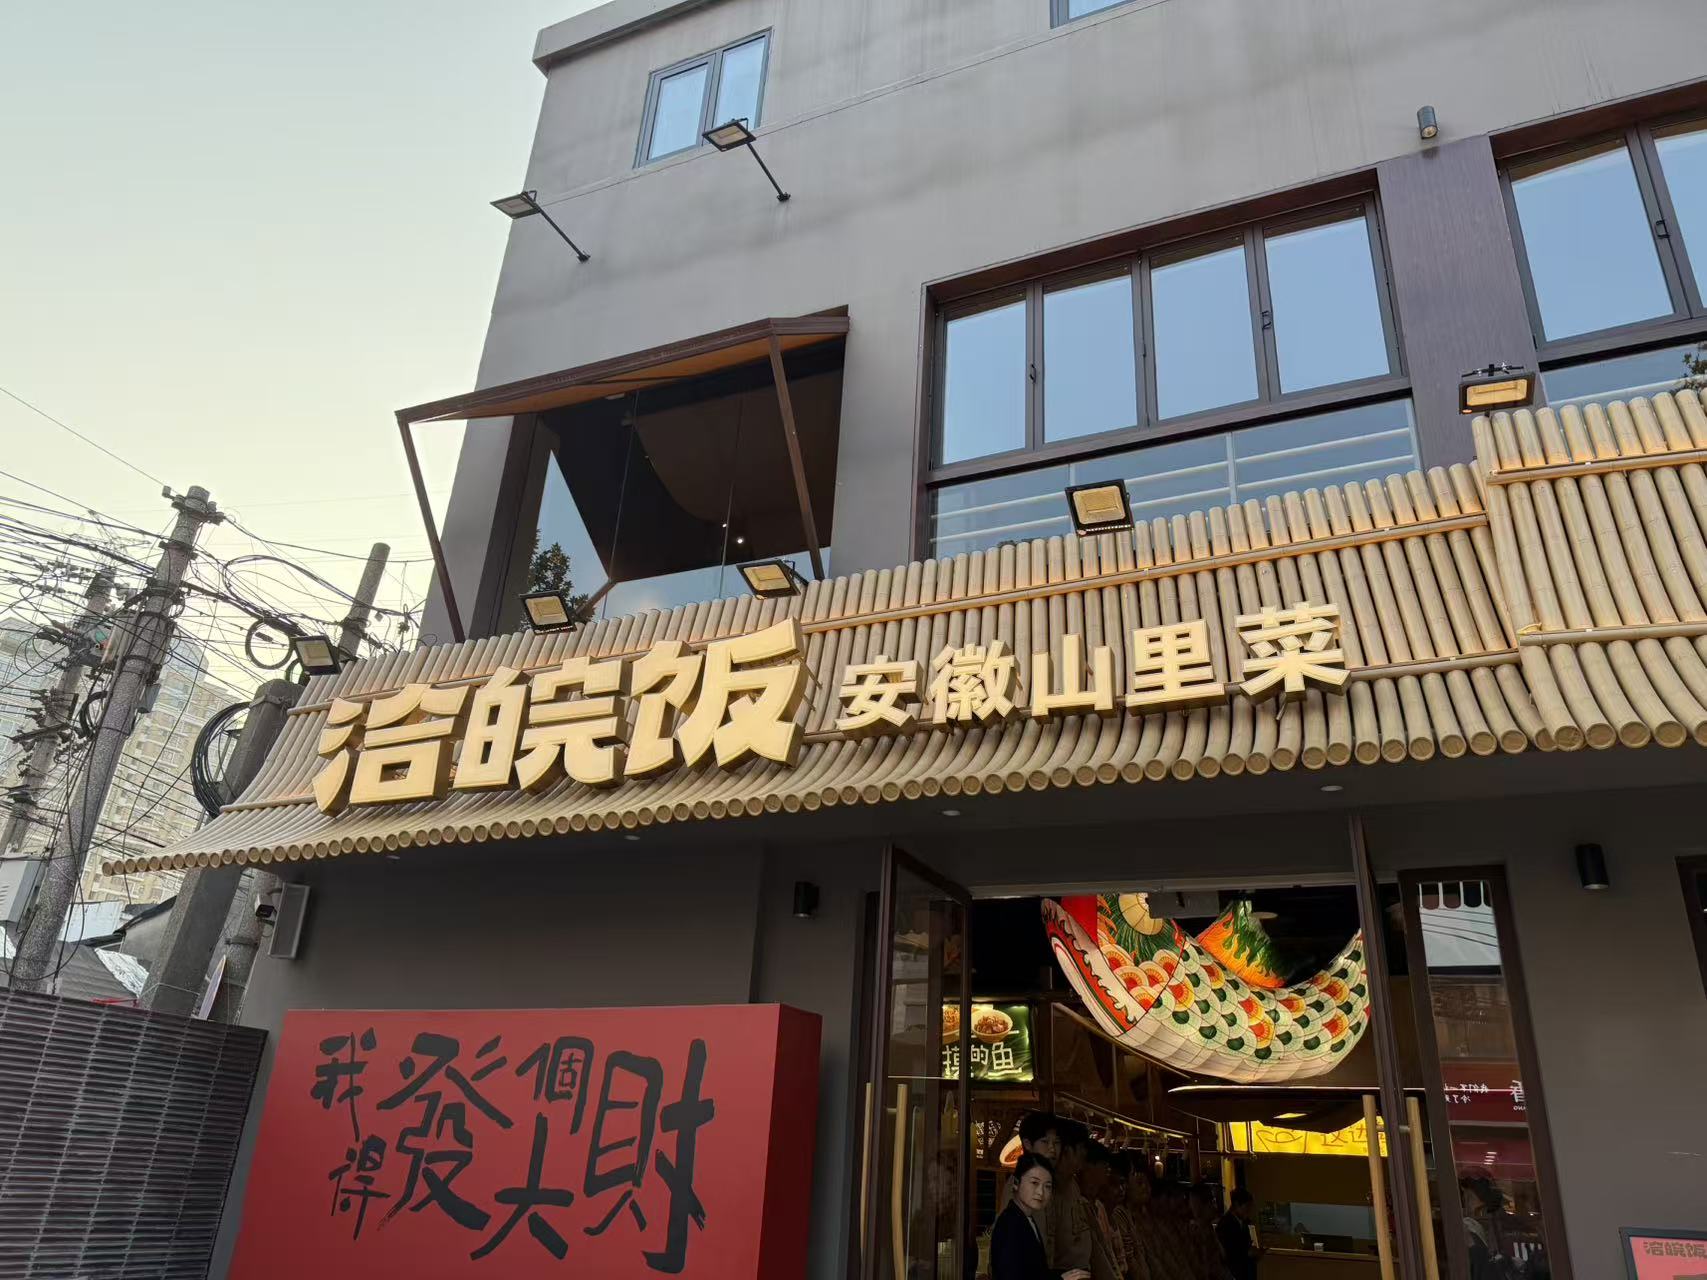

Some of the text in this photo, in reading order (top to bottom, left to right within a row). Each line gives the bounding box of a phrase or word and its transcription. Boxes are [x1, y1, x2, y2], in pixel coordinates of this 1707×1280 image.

[835, 601, 1351, 734] 安徽山里菜
